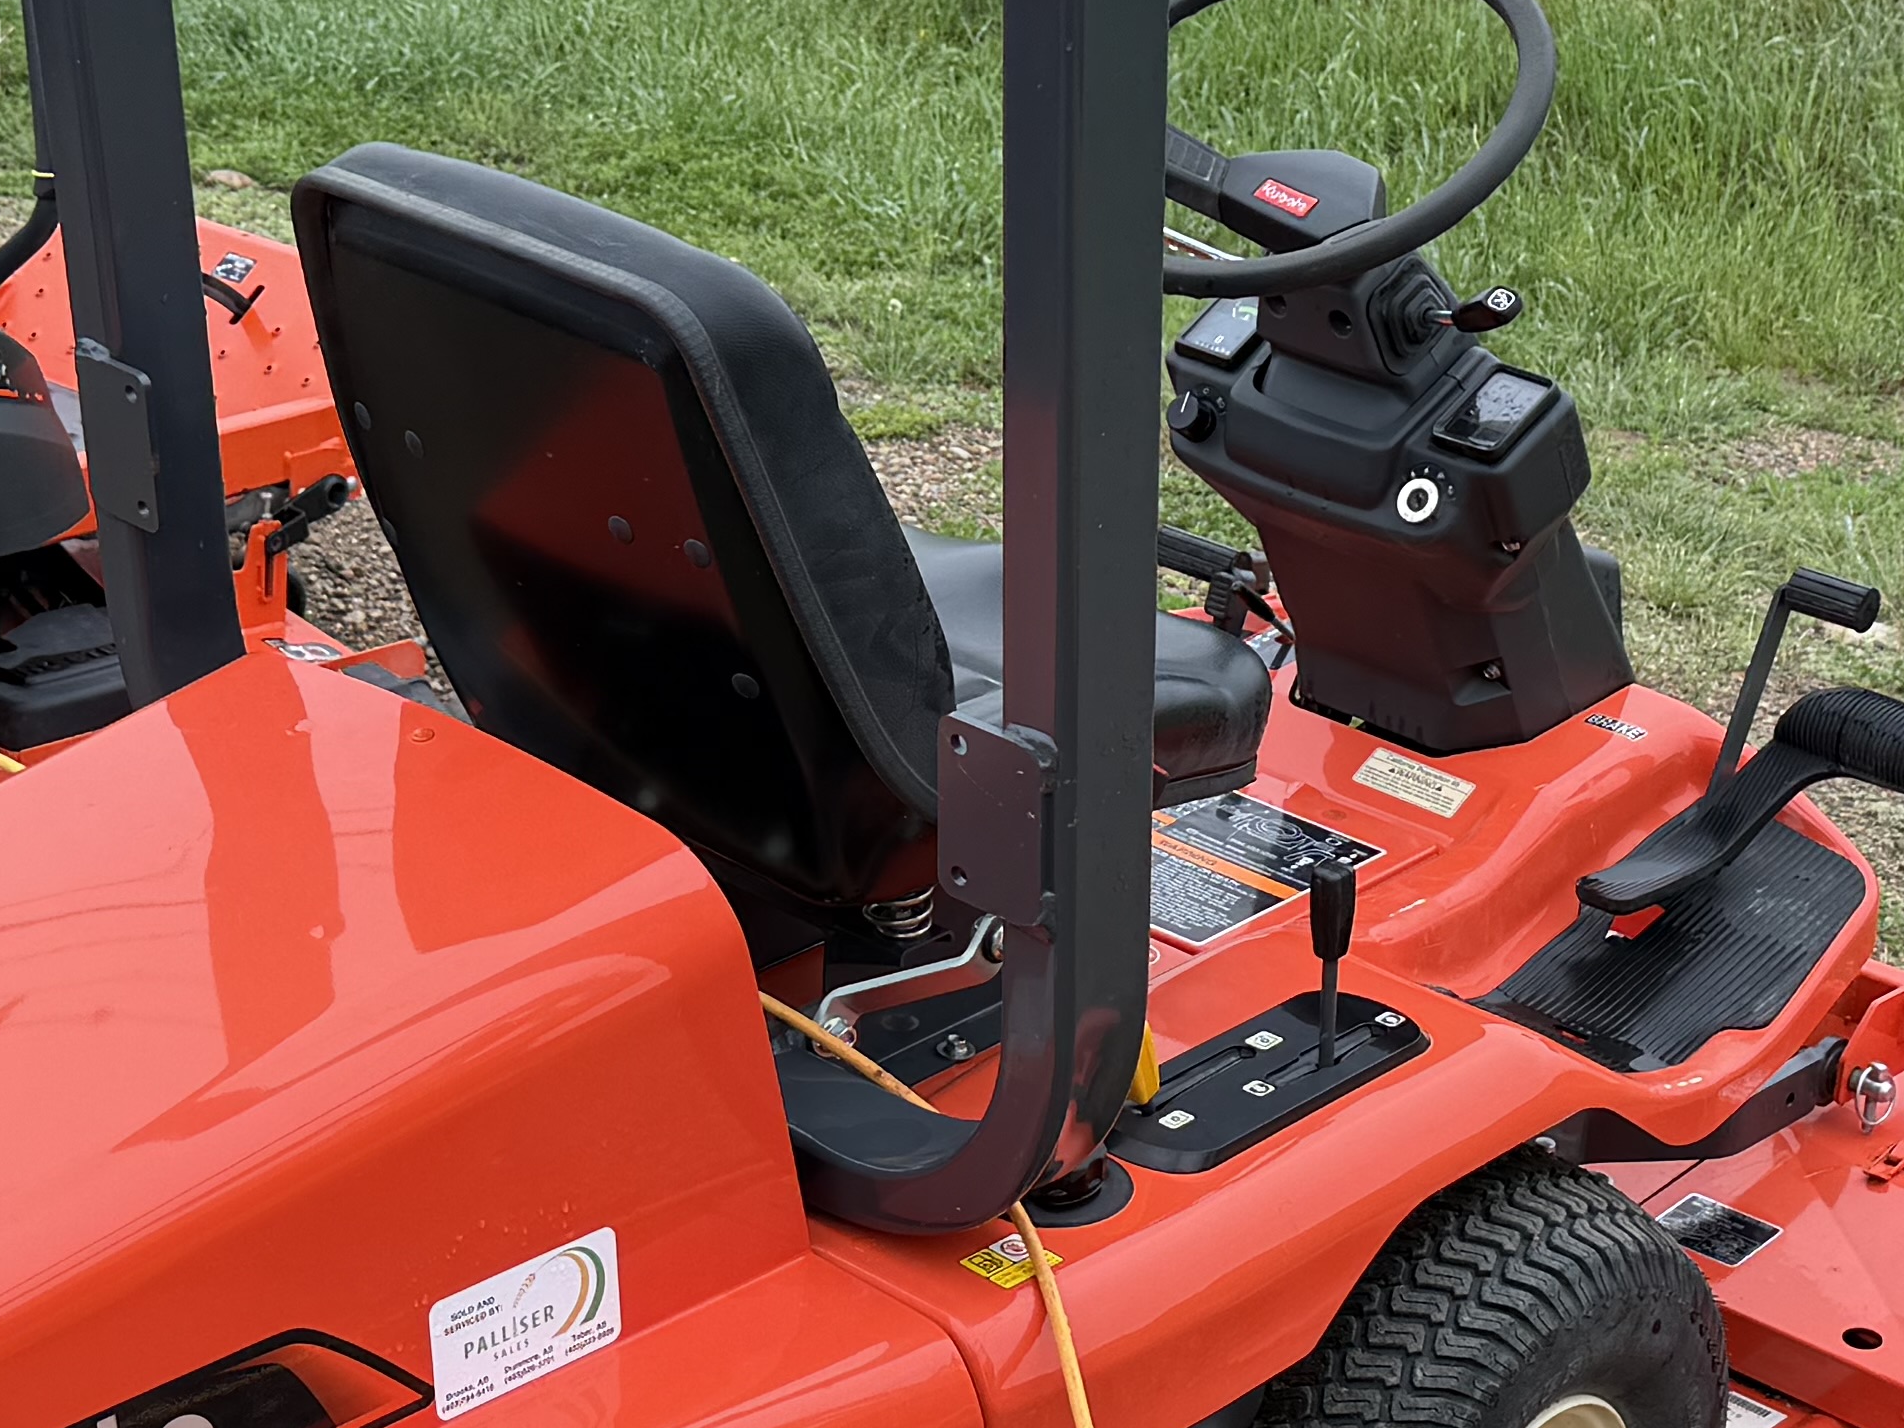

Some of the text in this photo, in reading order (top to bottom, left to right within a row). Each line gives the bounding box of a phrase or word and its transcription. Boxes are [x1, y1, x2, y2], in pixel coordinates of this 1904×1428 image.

[1586, 714, 1644, 740] BRAKE
[450, 1296, 495, 1322] SOLD AND
[464, 1304, 555, 1360] PALLISER
[494, 1338, 530, 1361] SALES
